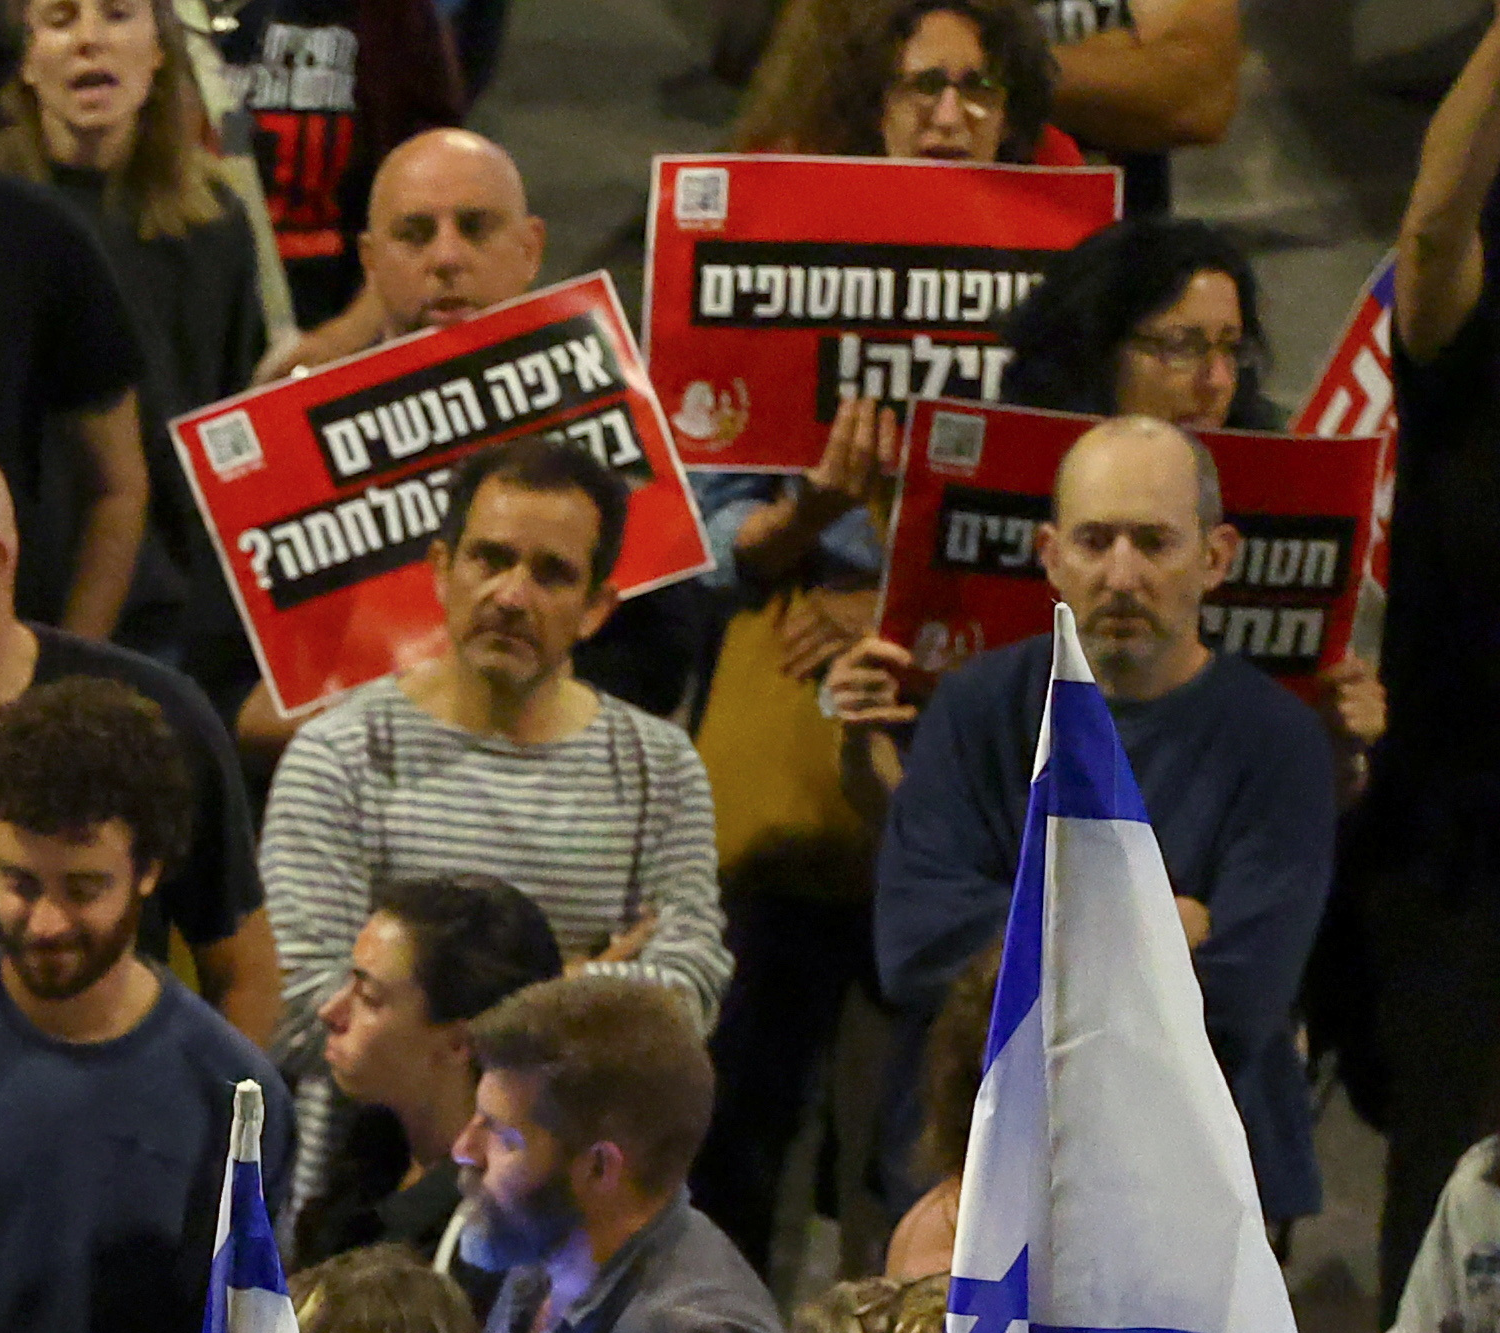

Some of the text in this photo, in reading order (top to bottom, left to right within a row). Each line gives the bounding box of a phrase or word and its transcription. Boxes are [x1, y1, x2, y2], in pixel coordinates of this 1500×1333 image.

[701, 264, 896, 321] וחטופים
[321, 333, 614, 477] איפה הנשים
